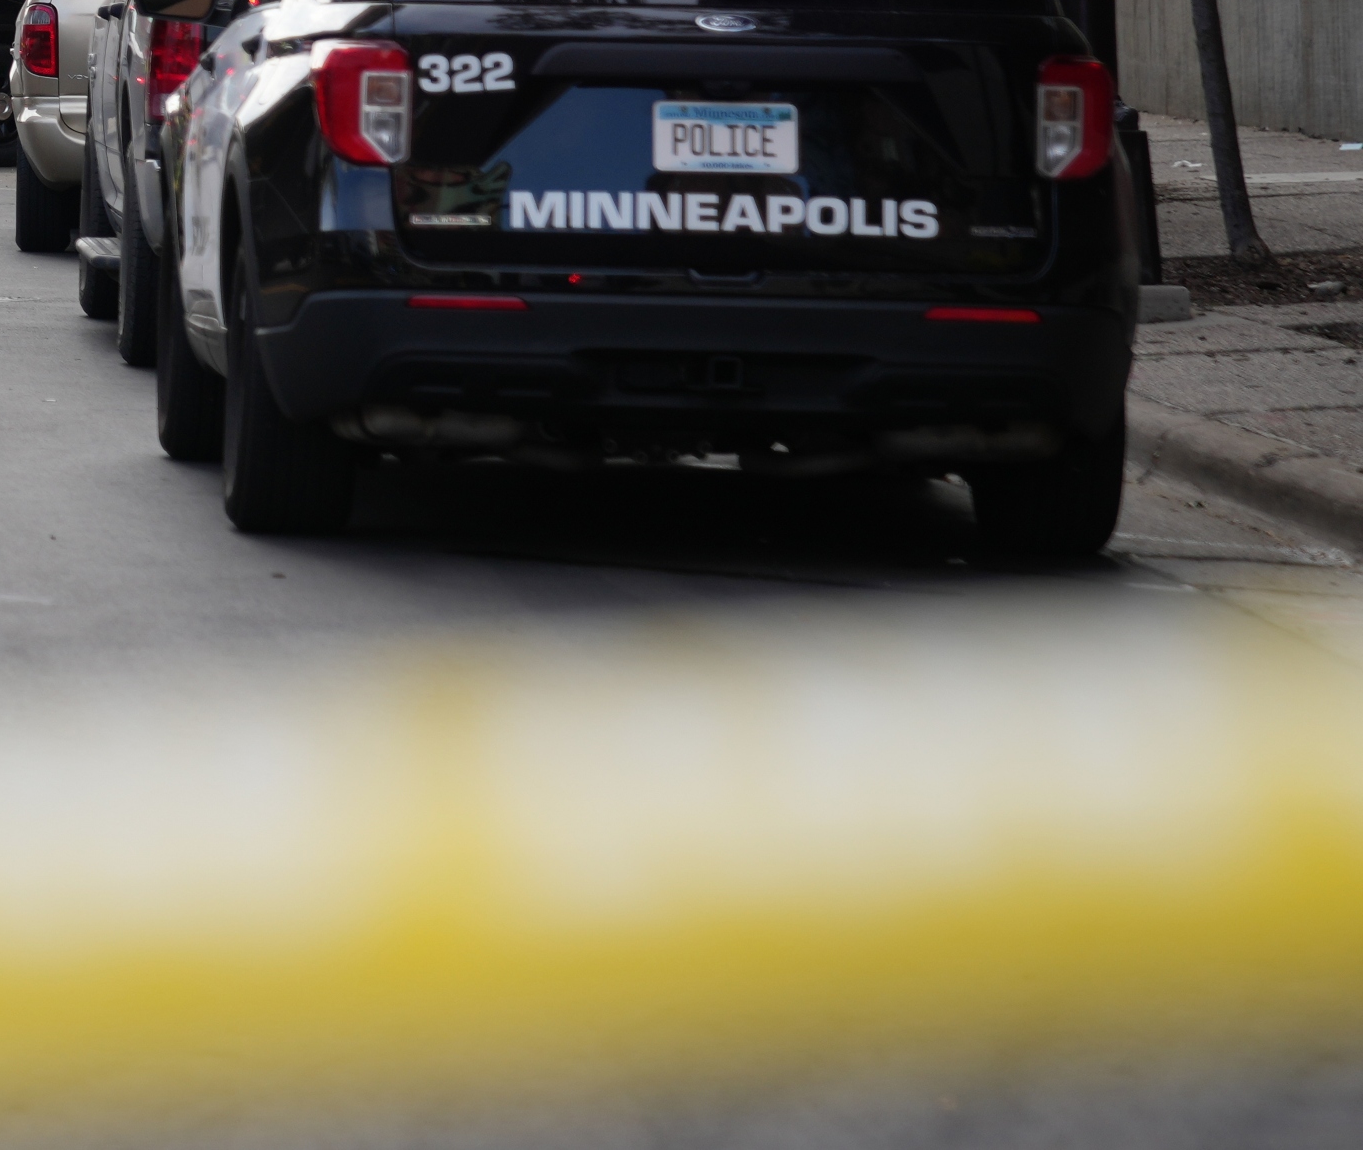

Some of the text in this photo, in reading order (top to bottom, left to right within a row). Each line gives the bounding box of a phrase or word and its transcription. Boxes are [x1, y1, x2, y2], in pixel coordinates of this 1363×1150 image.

[418, 52, 516, 93] 322
[672, 123, 777, 157] POLICE
[509, 190, 939, 239] MINNEAPOLIS
